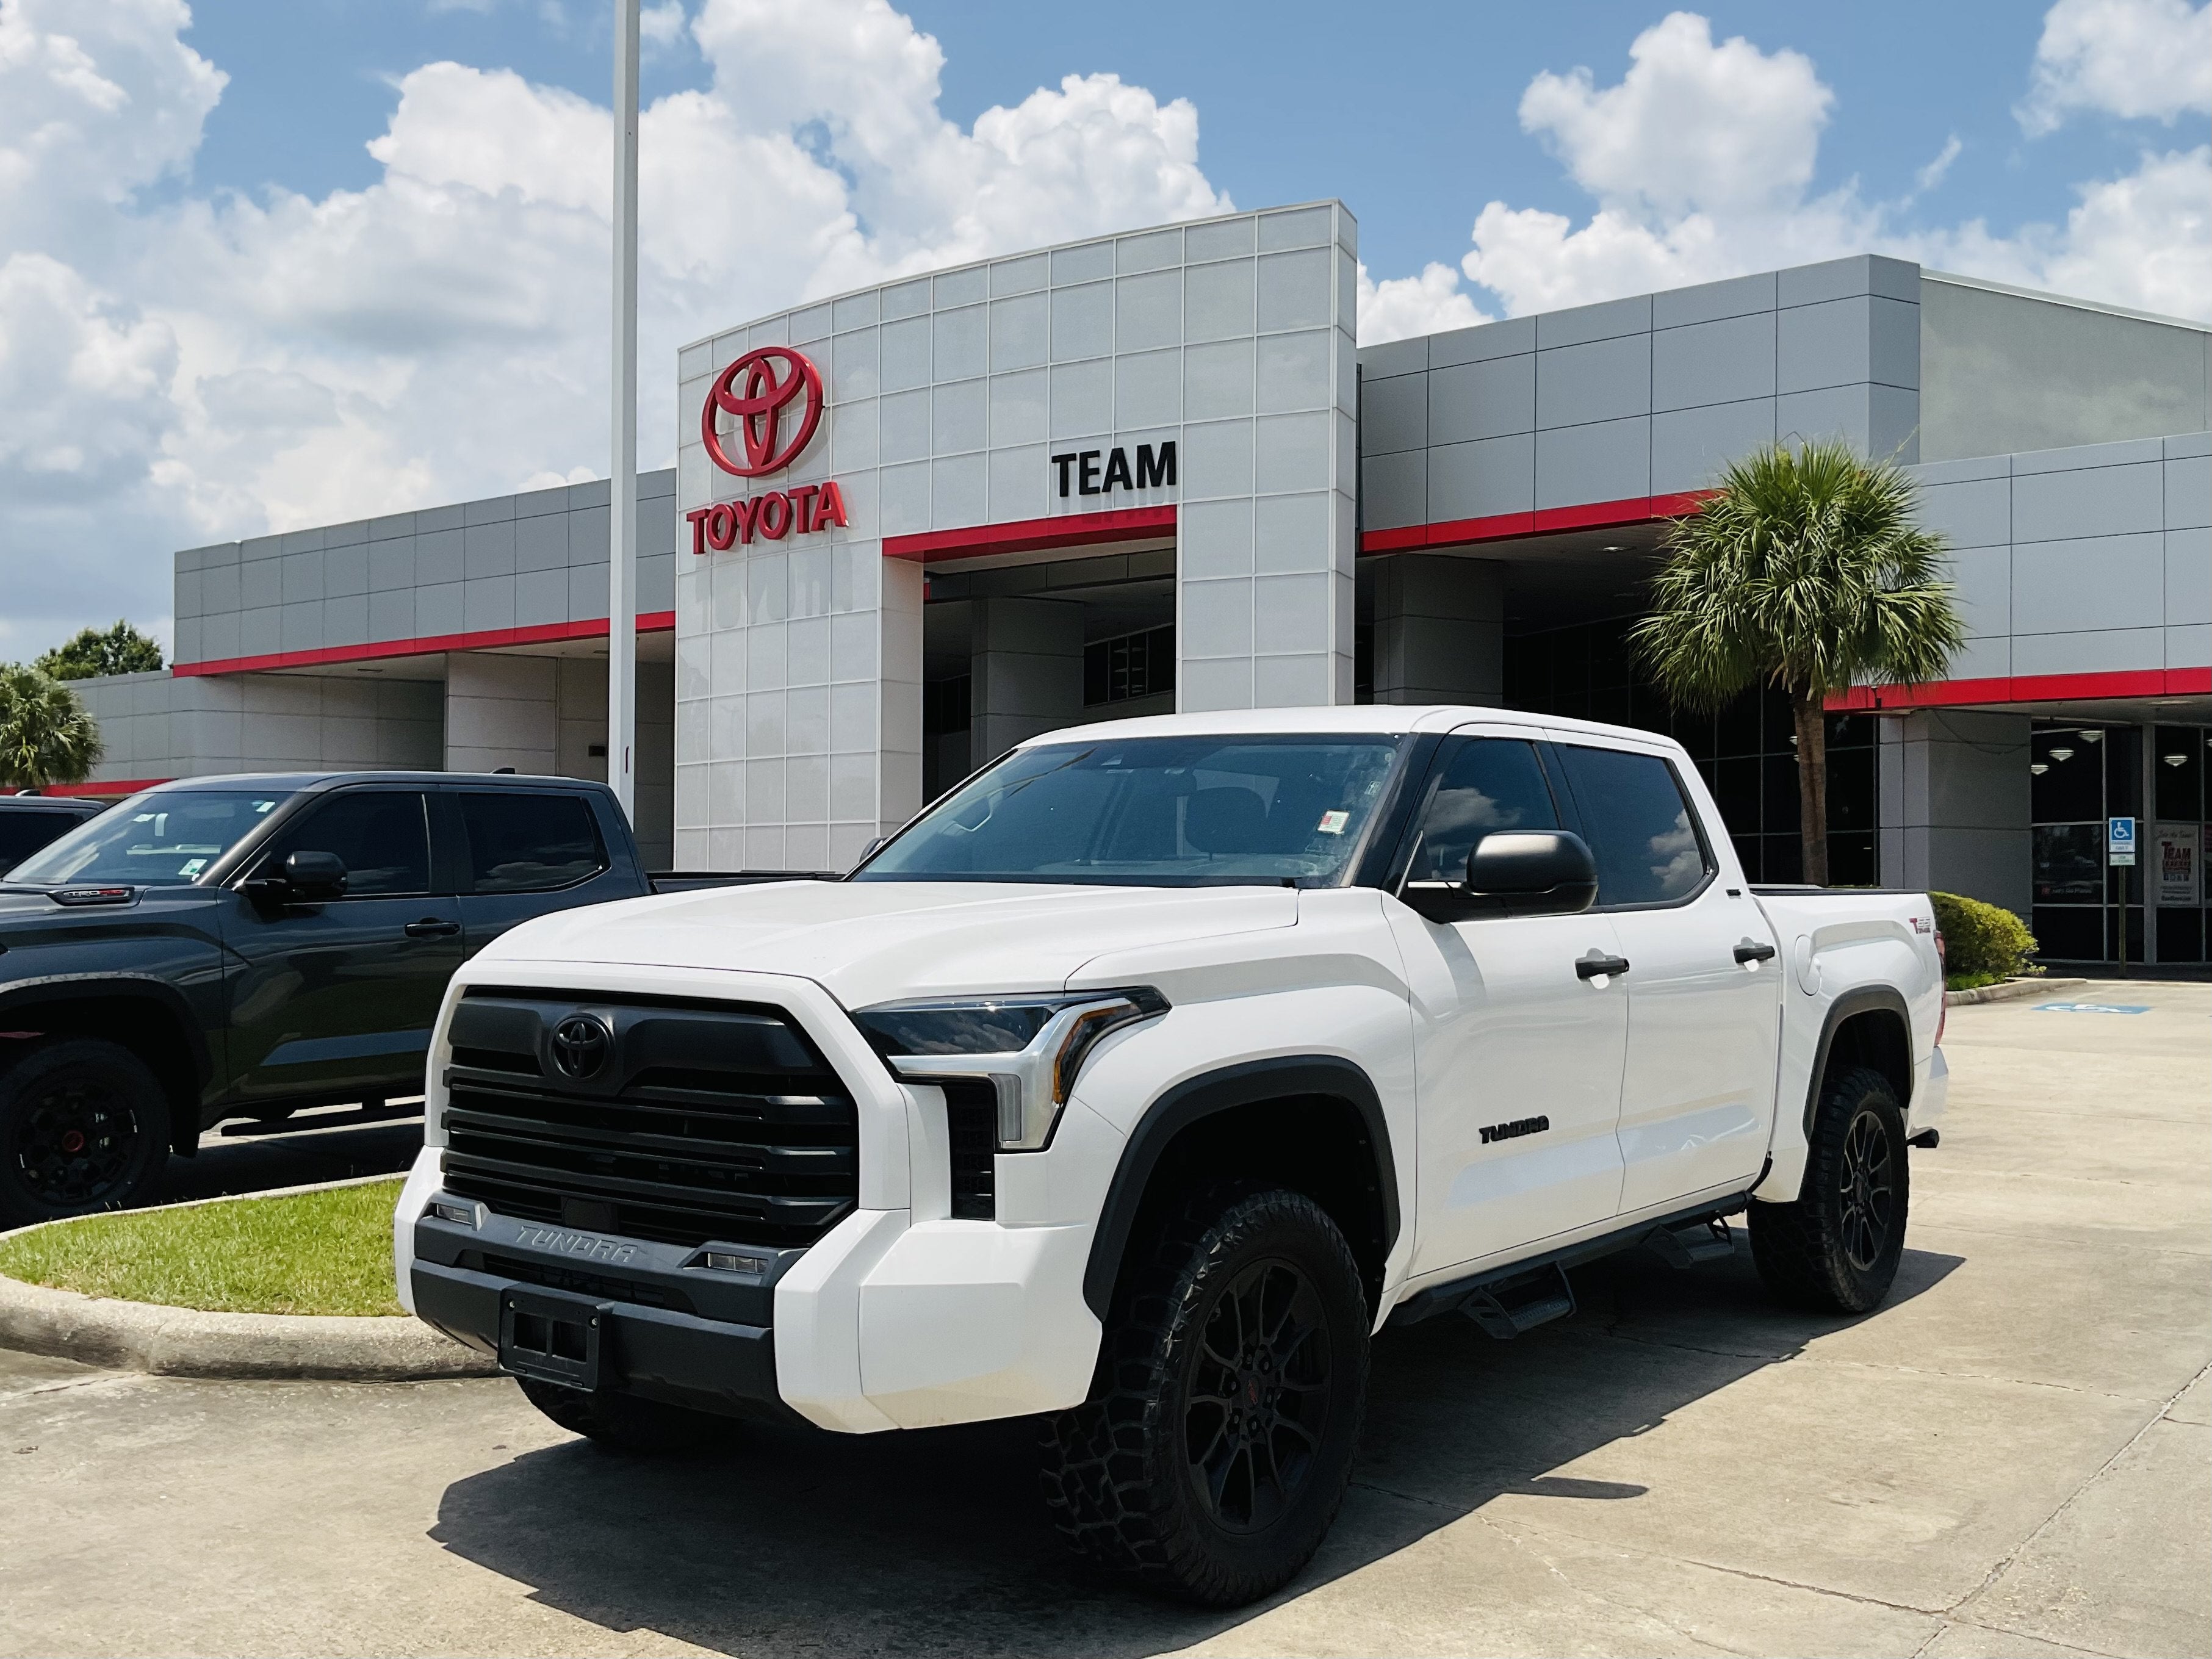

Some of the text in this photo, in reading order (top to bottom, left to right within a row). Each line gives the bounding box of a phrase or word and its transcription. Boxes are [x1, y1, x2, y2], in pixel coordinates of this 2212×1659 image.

[1051, 441, 1177, 497] TEAM
[686, 481, 848, 555] TOYOTA
[2161, 841, 2191, 860] TEAM
[1479, 1115, 1549, 1144] TUNDRA
[516, 1225, 639, 1263] TUNDRA
